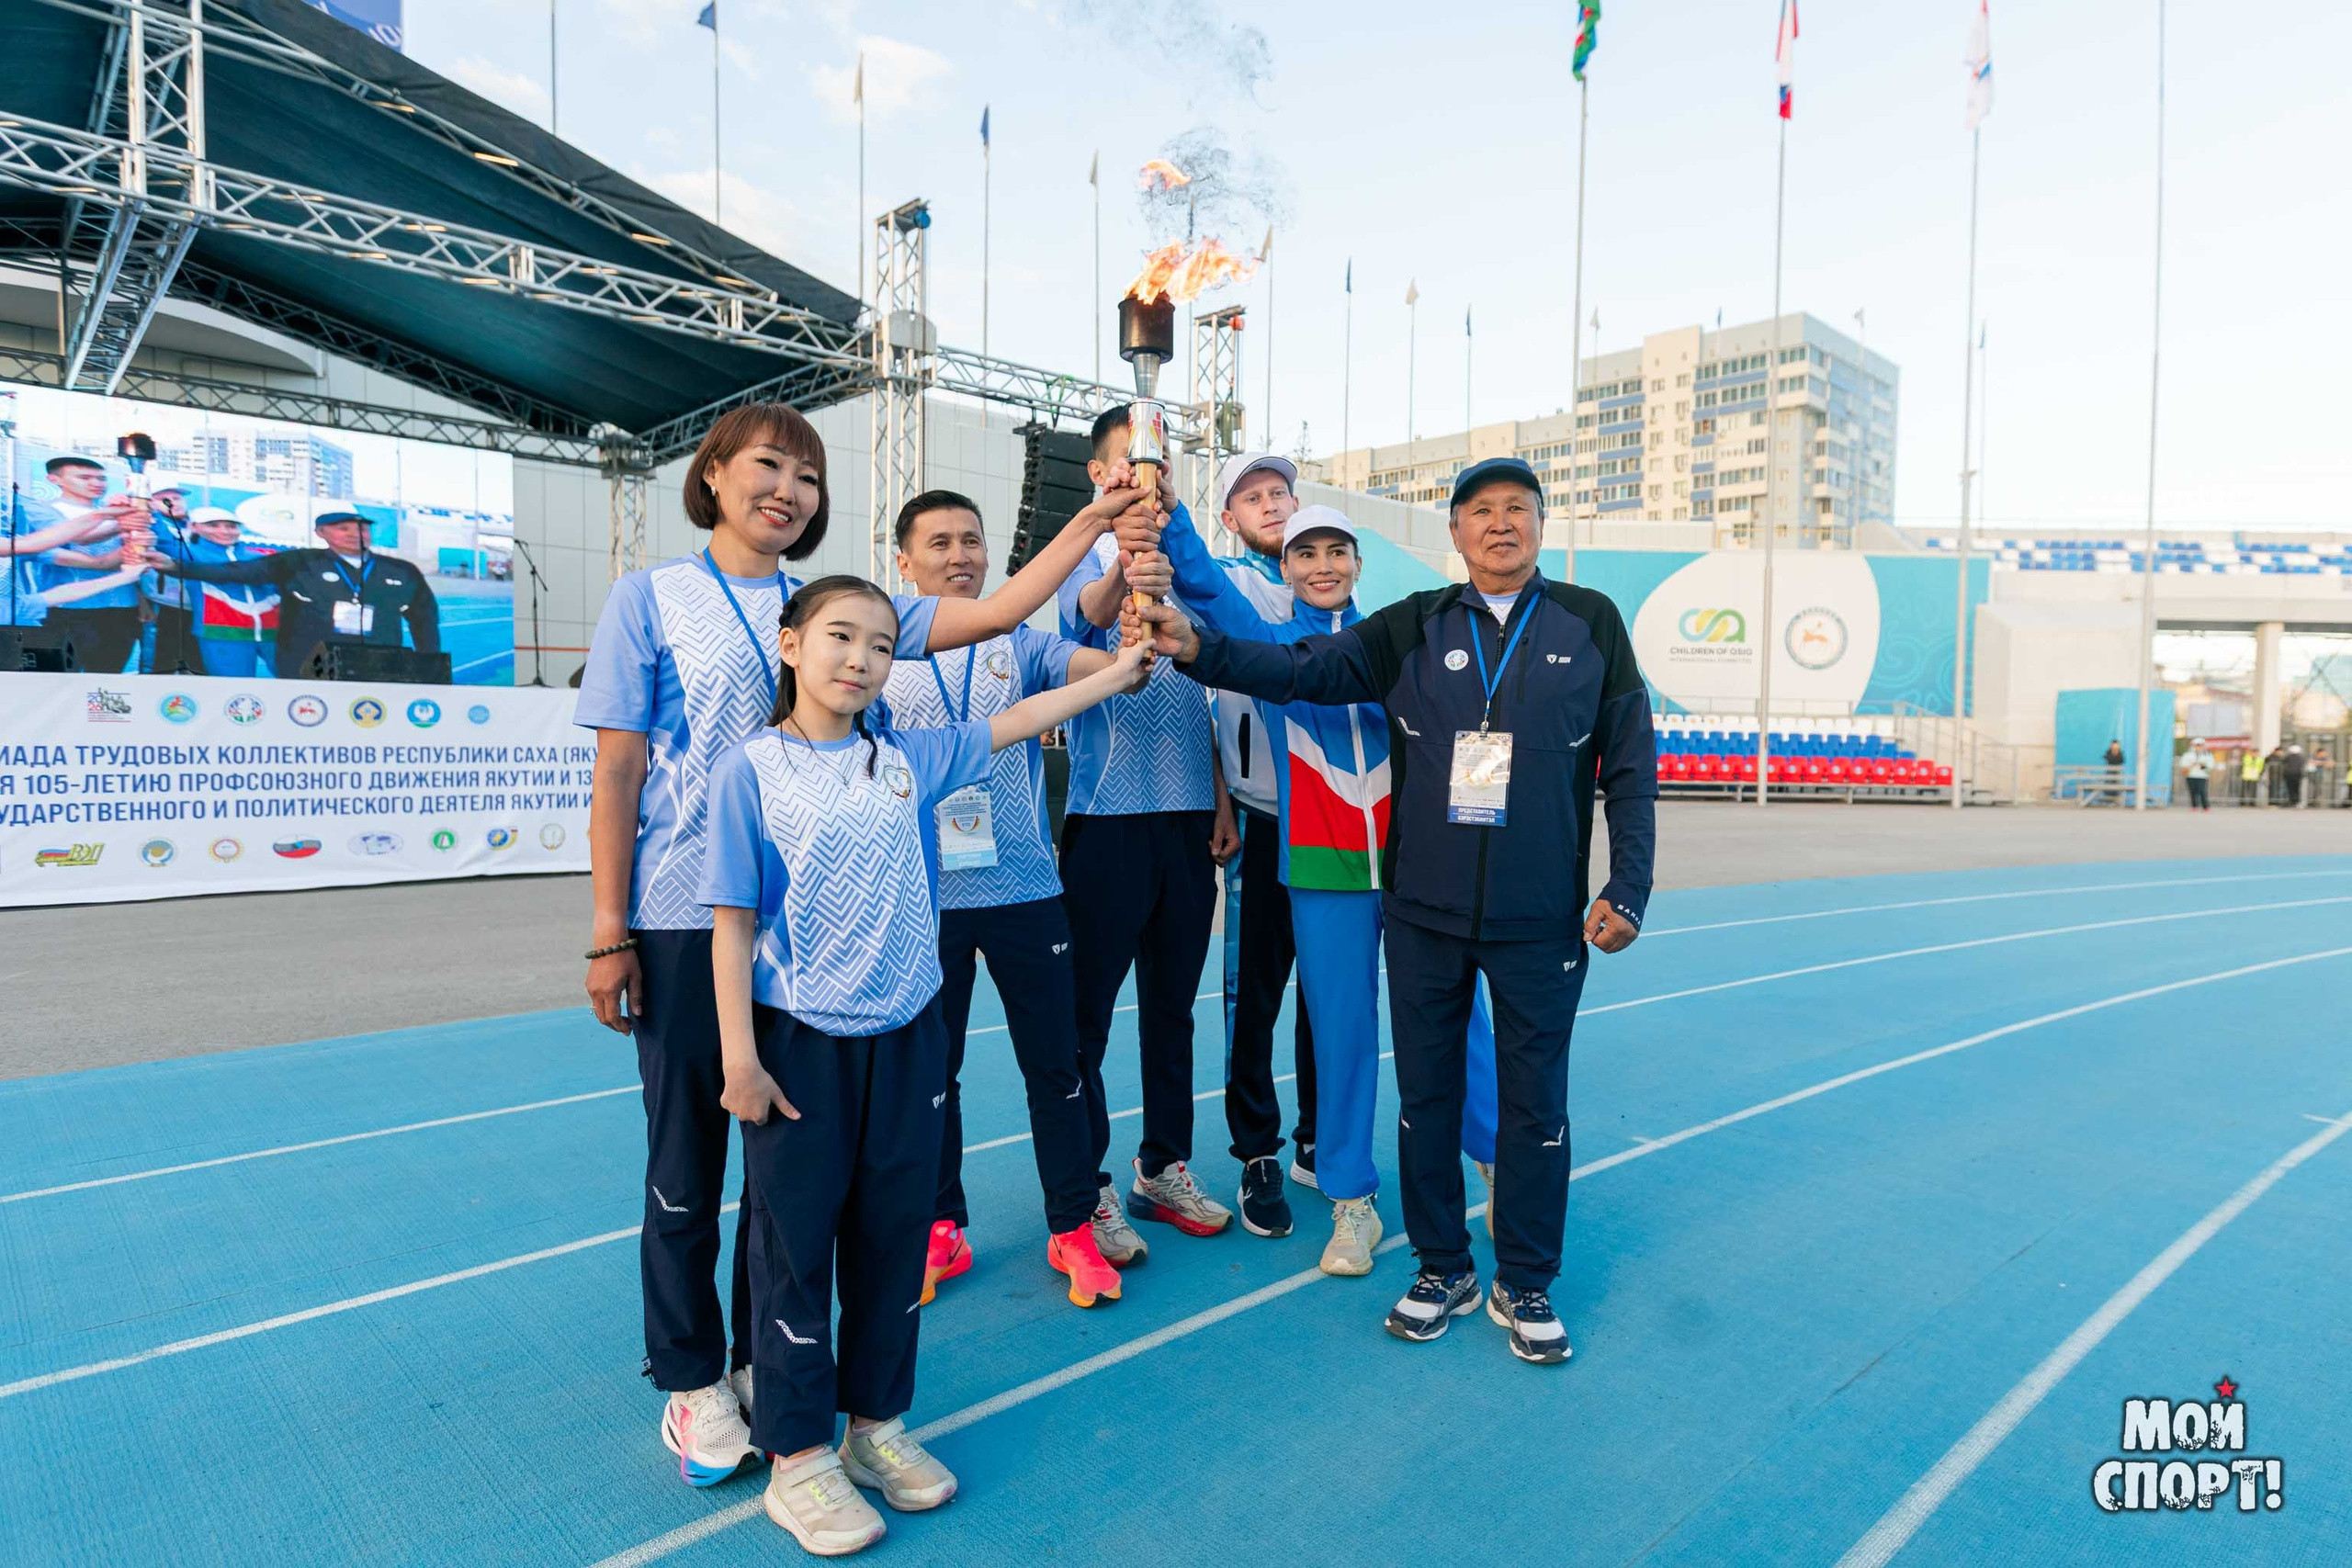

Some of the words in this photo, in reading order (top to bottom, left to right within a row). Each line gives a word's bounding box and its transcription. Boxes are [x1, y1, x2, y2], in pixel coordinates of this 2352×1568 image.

[1670, 647, 1714, 656] CHILDREN
[1716, 647, 1727, 656] OF
[75, 745, 210, 768] ТРУДОВЫХ
[218, 746, 376, 763] КОЛЛЕКТИВОВ
[383, 746, 508, 764] РЕСПУБЛИКИ
[514, 746, 558, 763] САХА
[0, 774, 15, 795] Я
[24, 773, 172, 795] 105-ЛЕТИЮ
[179, 772, 362, 793] ПРОФСОЮЗНОГО
[368, 770, 480, 791] ДВИЖЕНИЯ
[485, 770, 554, 787] ЯКУТИИ
[560, 770, 570, 785] И
[213, 800, 227, 818] И
[235, 796, 413, 818] ПОЛИТИЧЕСКОГО
[419, 794, 505, 815] ДЕЯТЕЛЯ
[511, 793, 578, 811] ЯКУТИИ
